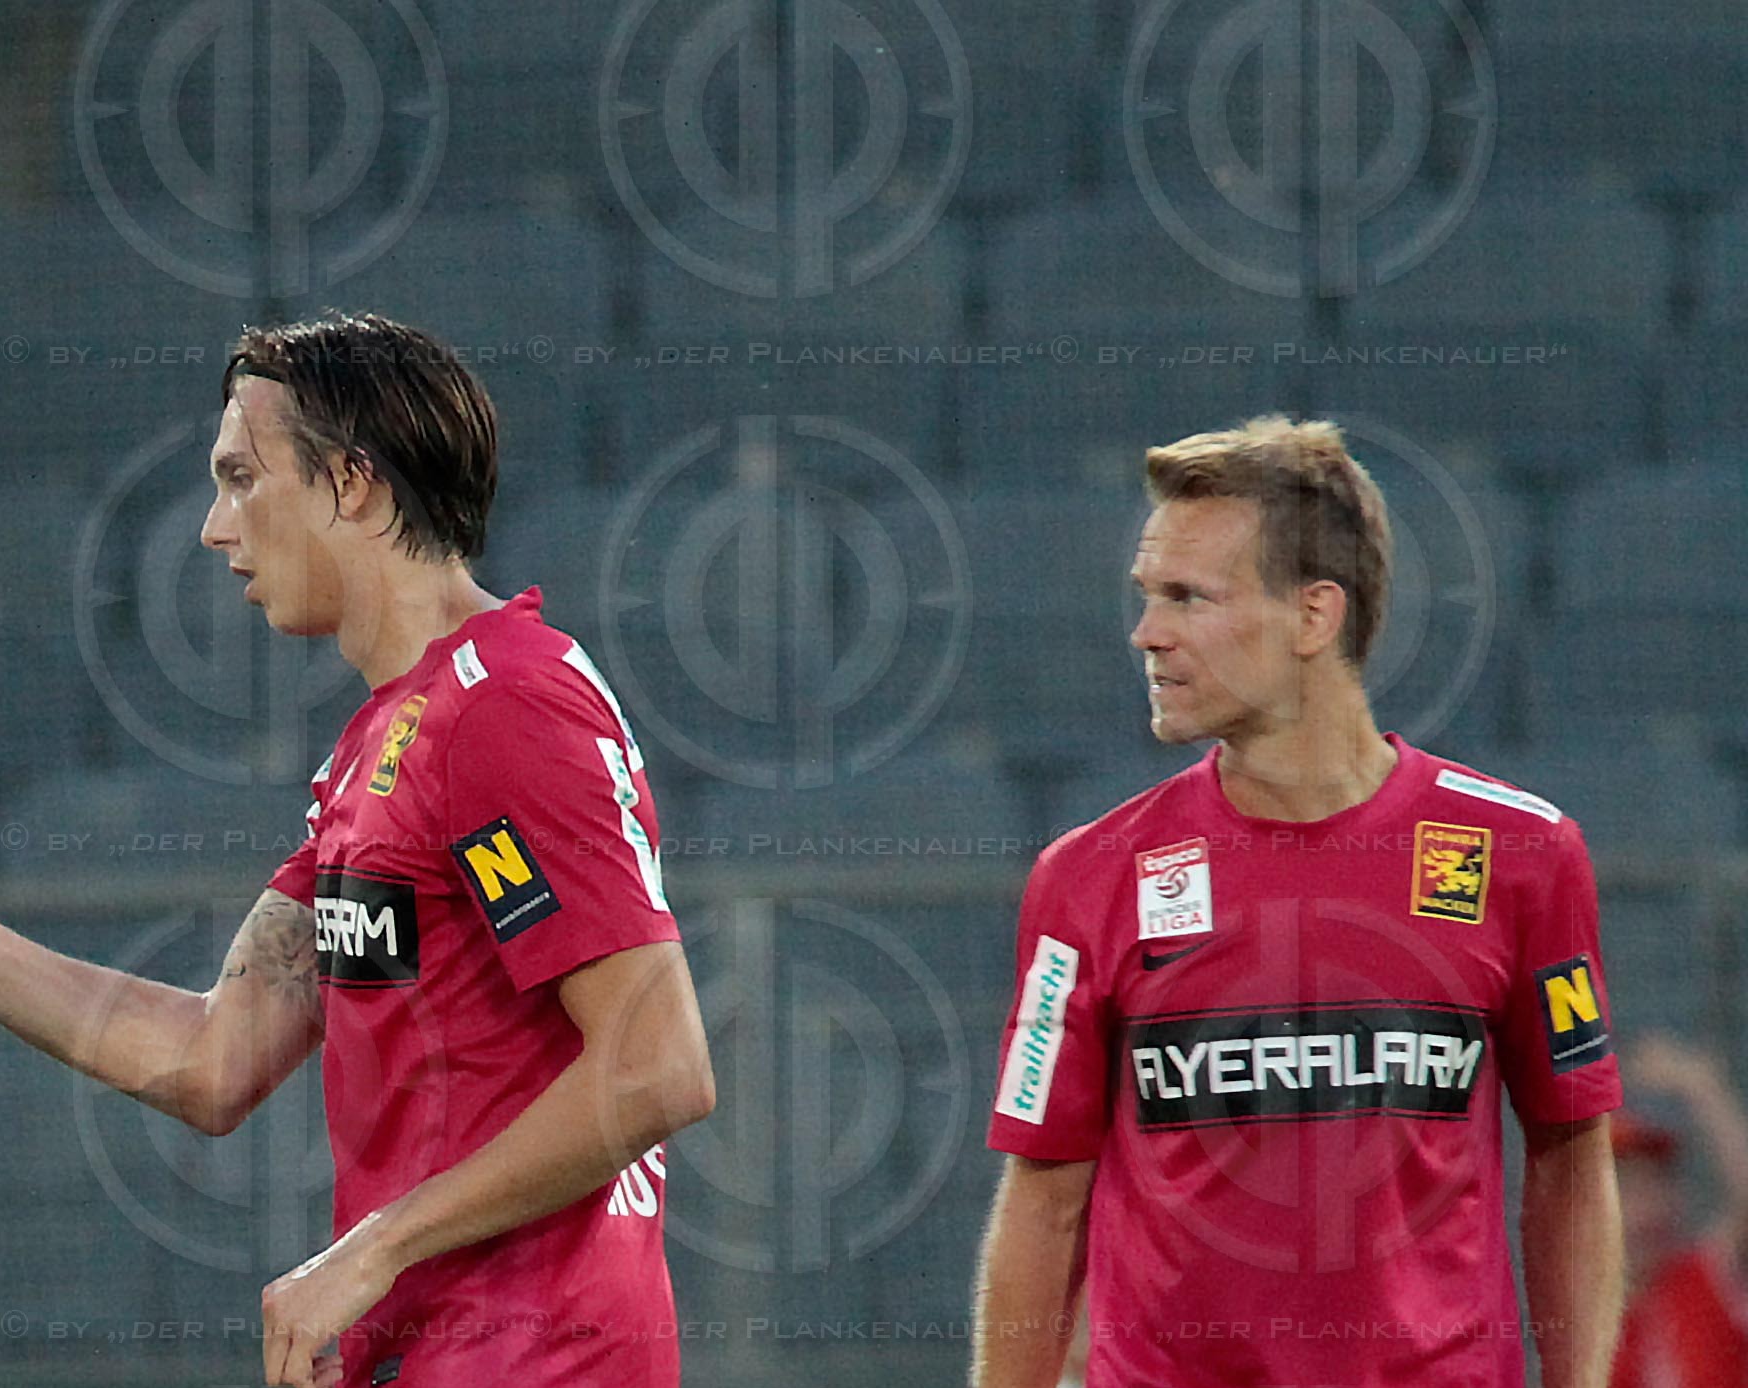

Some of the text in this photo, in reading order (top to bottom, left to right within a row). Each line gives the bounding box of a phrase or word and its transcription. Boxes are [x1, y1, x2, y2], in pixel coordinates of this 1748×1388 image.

[464, 829, 533, 902] N
[1148, 912, 1204, 934] LIGA
[1544, 966, 1600, 1033] N
[1132, 1031, 1484, 1100] FLYERALARM
